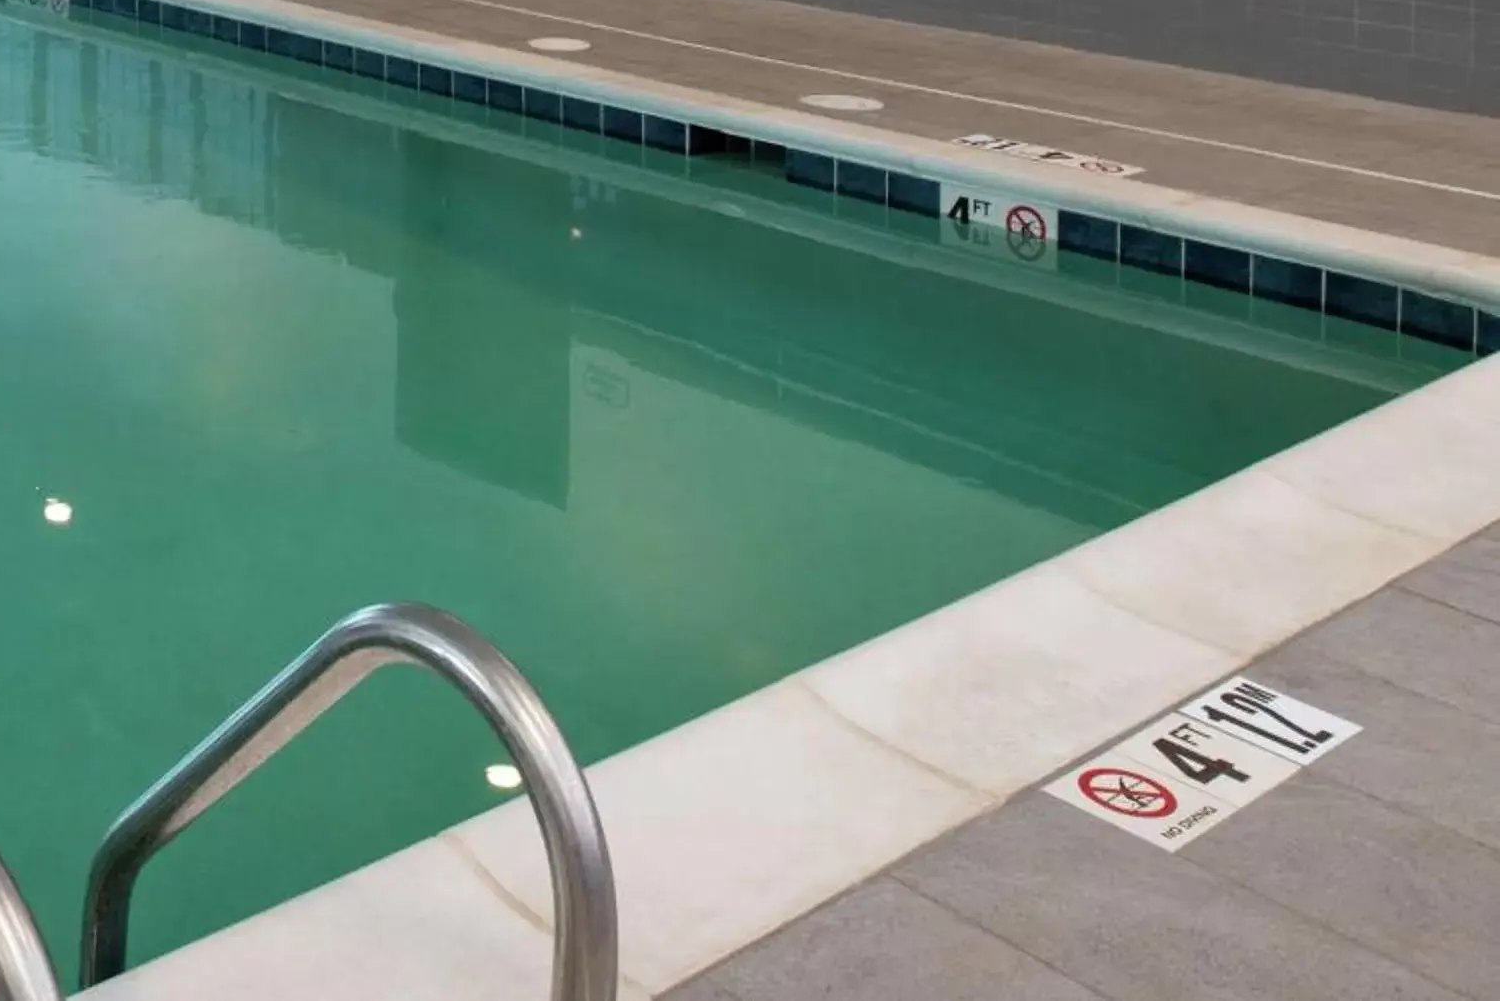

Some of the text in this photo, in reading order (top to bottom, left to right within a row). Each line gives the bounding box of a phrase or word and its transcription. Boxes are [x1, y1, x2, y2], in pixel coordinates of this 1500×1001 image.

[973, 199, 993, 217] FT
[1168, 722, 1214, 748] FT
[1152, 737, 1251, 785] 4
[1160, 805, 1217, 840] NO DIVING
